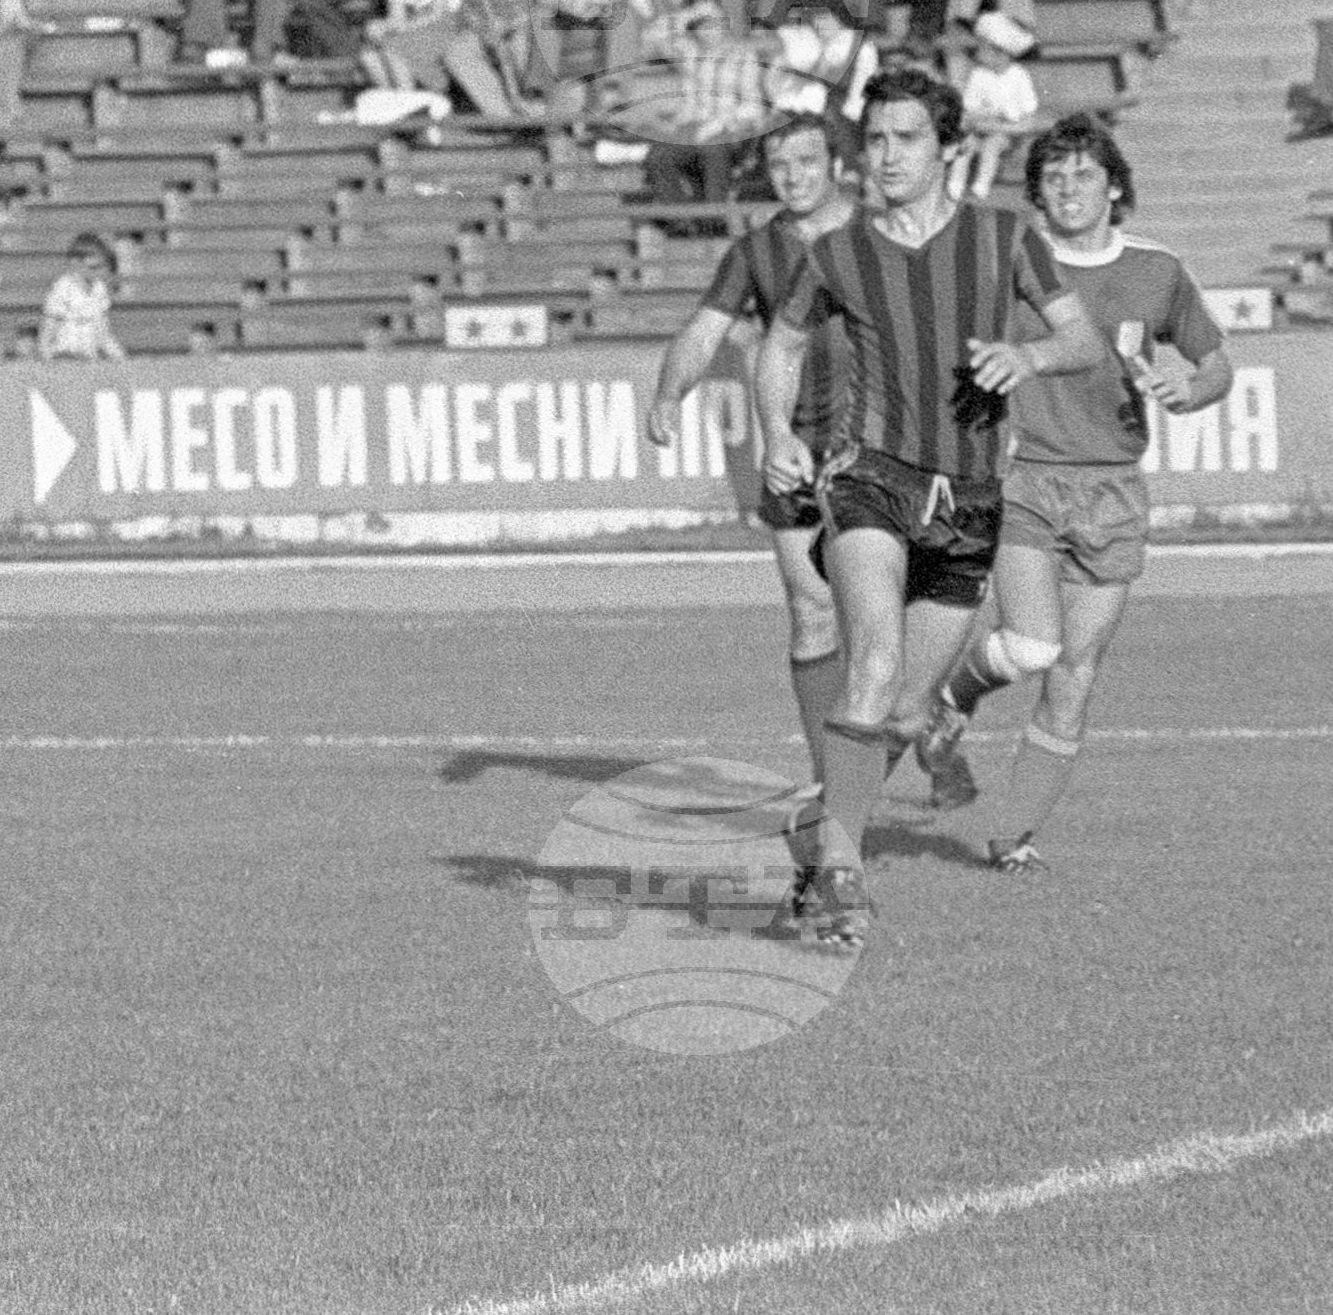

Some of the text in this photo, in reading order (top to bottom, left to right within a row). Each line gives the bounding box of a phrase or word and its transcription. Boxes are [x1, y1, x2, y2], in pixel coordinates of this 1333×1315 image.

[94, 386, 296, 493] МЕСО
[316, 383, 367, 485] И
[386, 381, 638, 485] МЕСНИ
